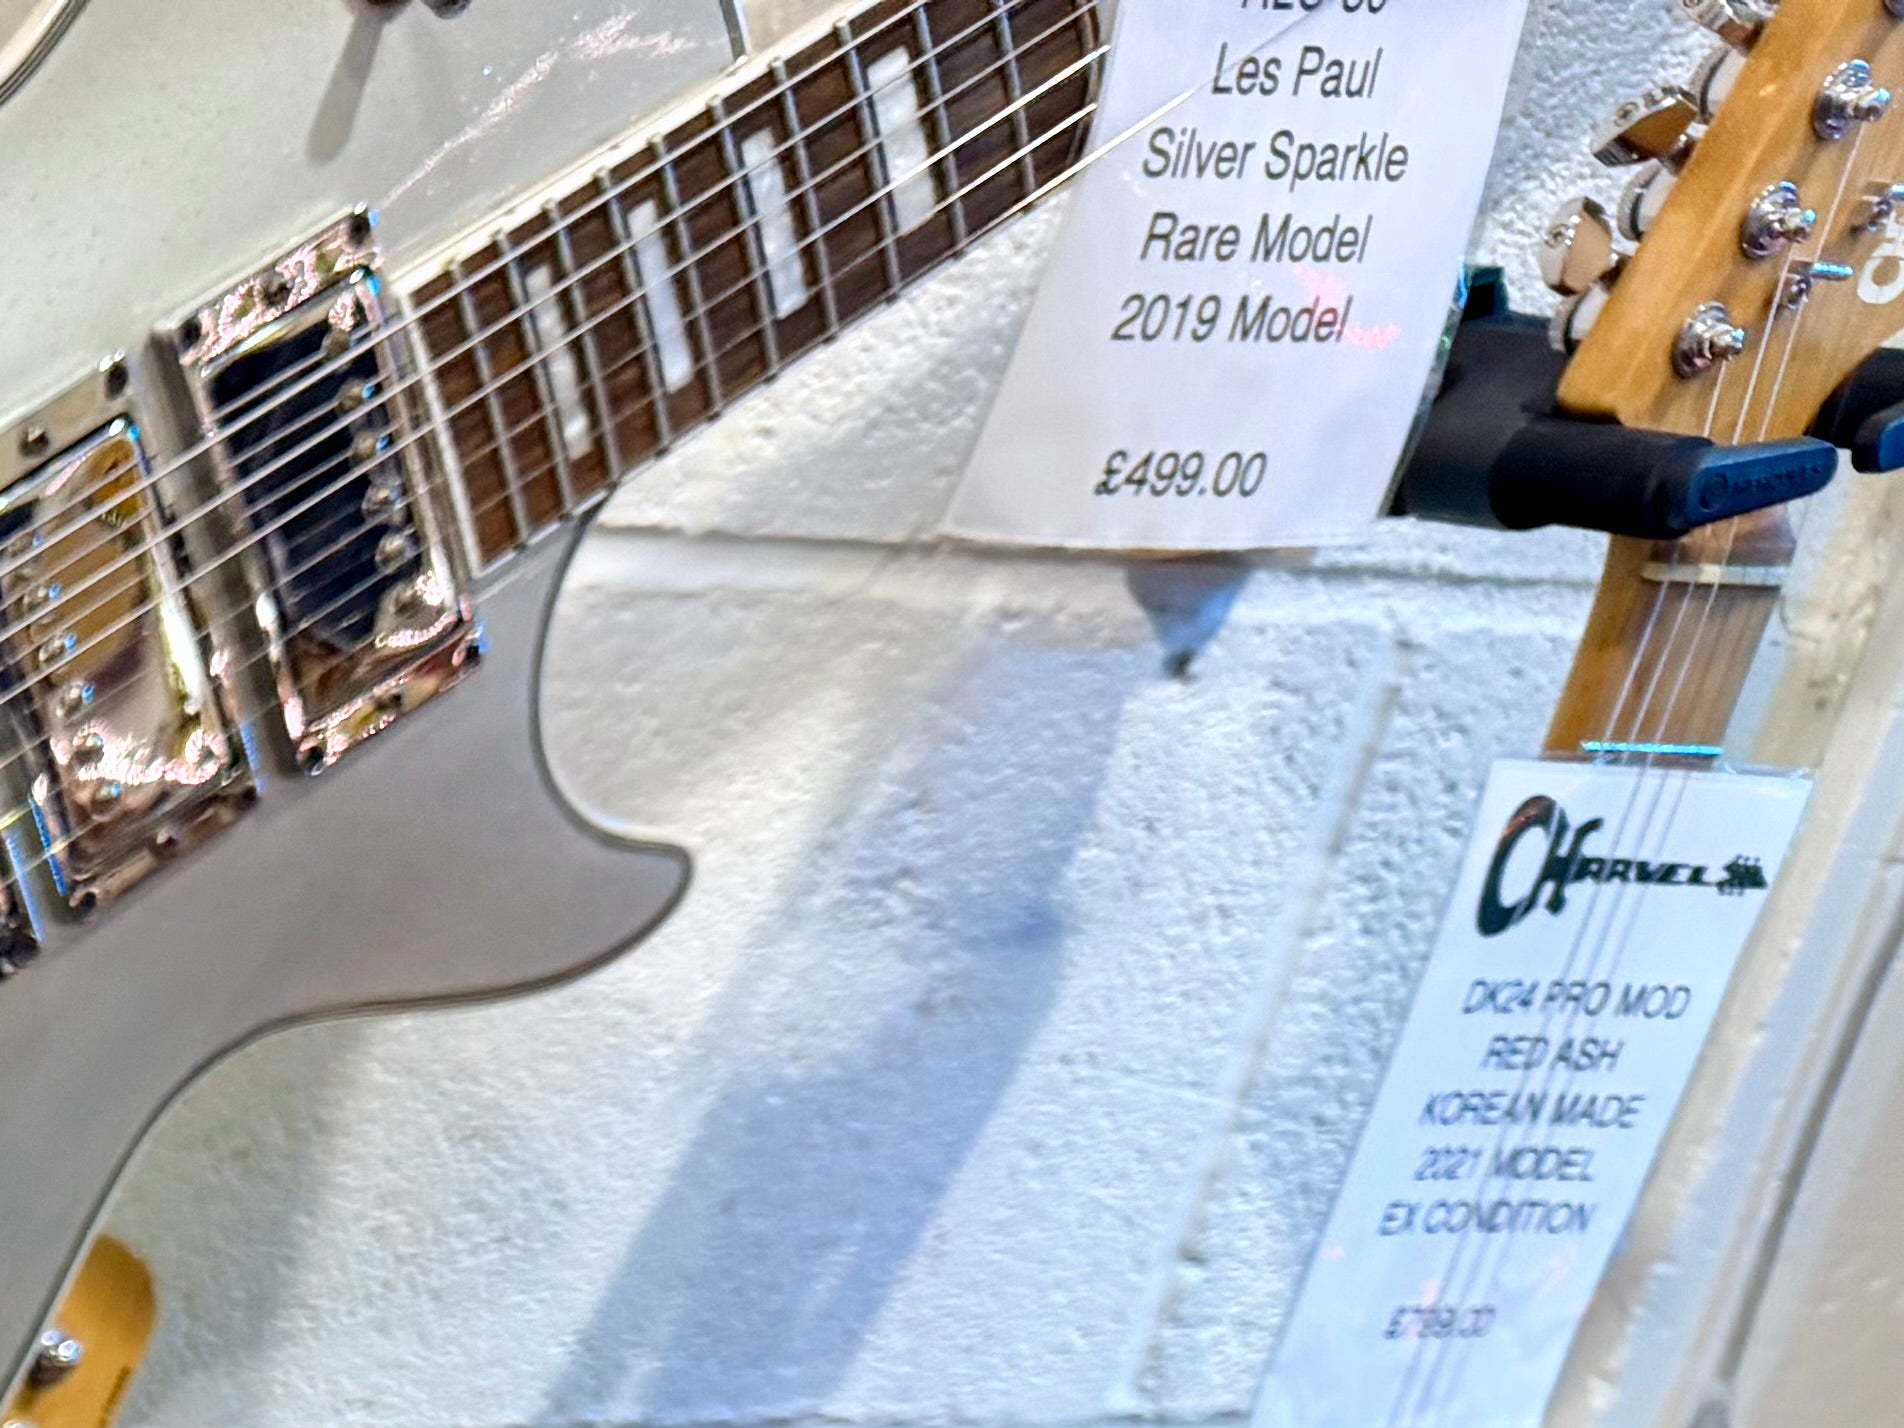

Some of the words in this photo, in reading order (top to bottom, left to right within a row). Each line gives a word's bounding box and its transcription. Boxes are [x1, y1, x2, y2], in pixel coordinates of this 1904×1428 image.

[1213, 43, 1281, 96] Les
[1293, 46, 1383, 99] Paul
[1142, 128, 1255, 180] Silver
[1265, 129, 1409, 192] Sparkle
[1141, 212, 1240, 261] Rare
[1252, 214, 1373, 264] Model
[1112, 294, 1223, 342] 2019
[1229, 296, 1352, 343] Model
[1094, 450, 1267, 497] £499.00
[1542, 979, 1611, 1016] PRO
[1614, 982, 1692, 1020] MOD
[1481, 1034, 1548, 1071] RED
[1552, 1036, 1625, 1072] ASH
[1419, 1091, 1548, 1126] KOREAN
[1549, 1093, 1647, 1129] MADE
[1492, 1146, 1595, 1182] MODEL
[1378, 1200, 1420, 1236] EX
[1423, 1199, 1595, 1234] CONDITION
